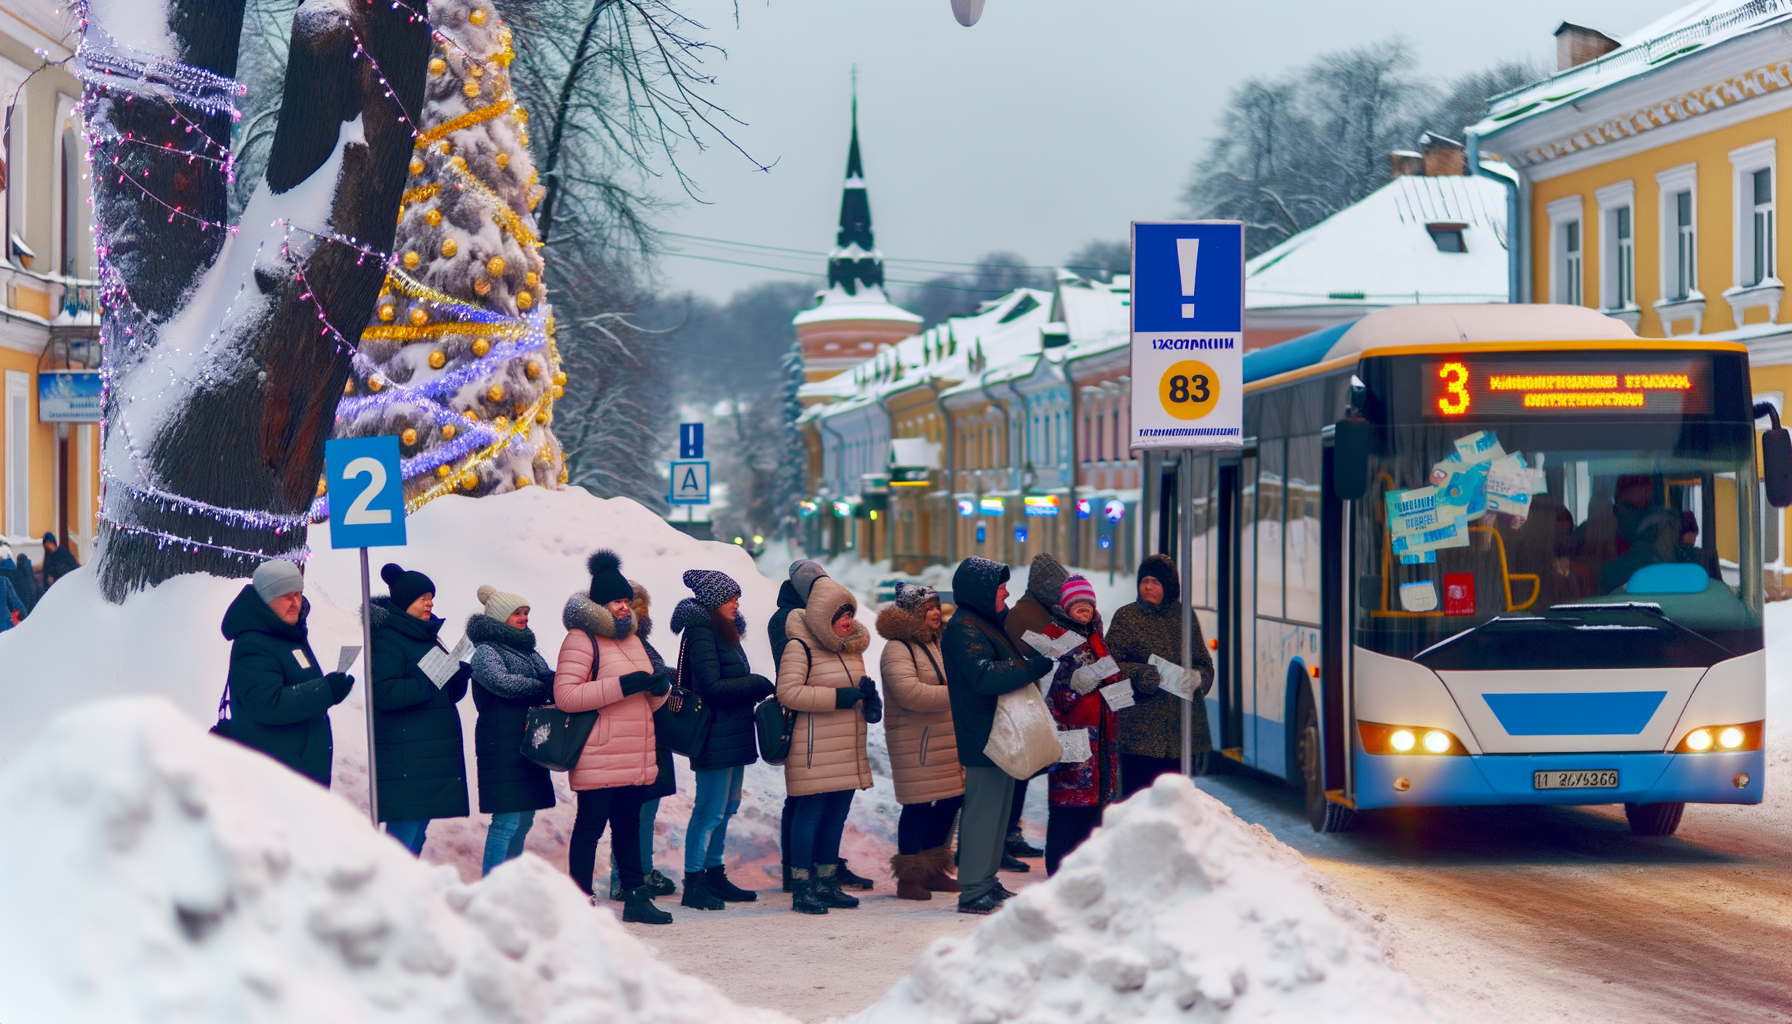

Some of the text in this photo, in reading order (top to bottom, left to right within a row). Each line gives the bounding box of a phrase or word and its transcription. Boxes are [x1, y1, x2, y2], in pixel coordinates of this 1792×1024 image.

[1169, 374, 1210, 404] 83
[1439, 362, 1470, 415] 3
[341, 456, 392, 526] 2
